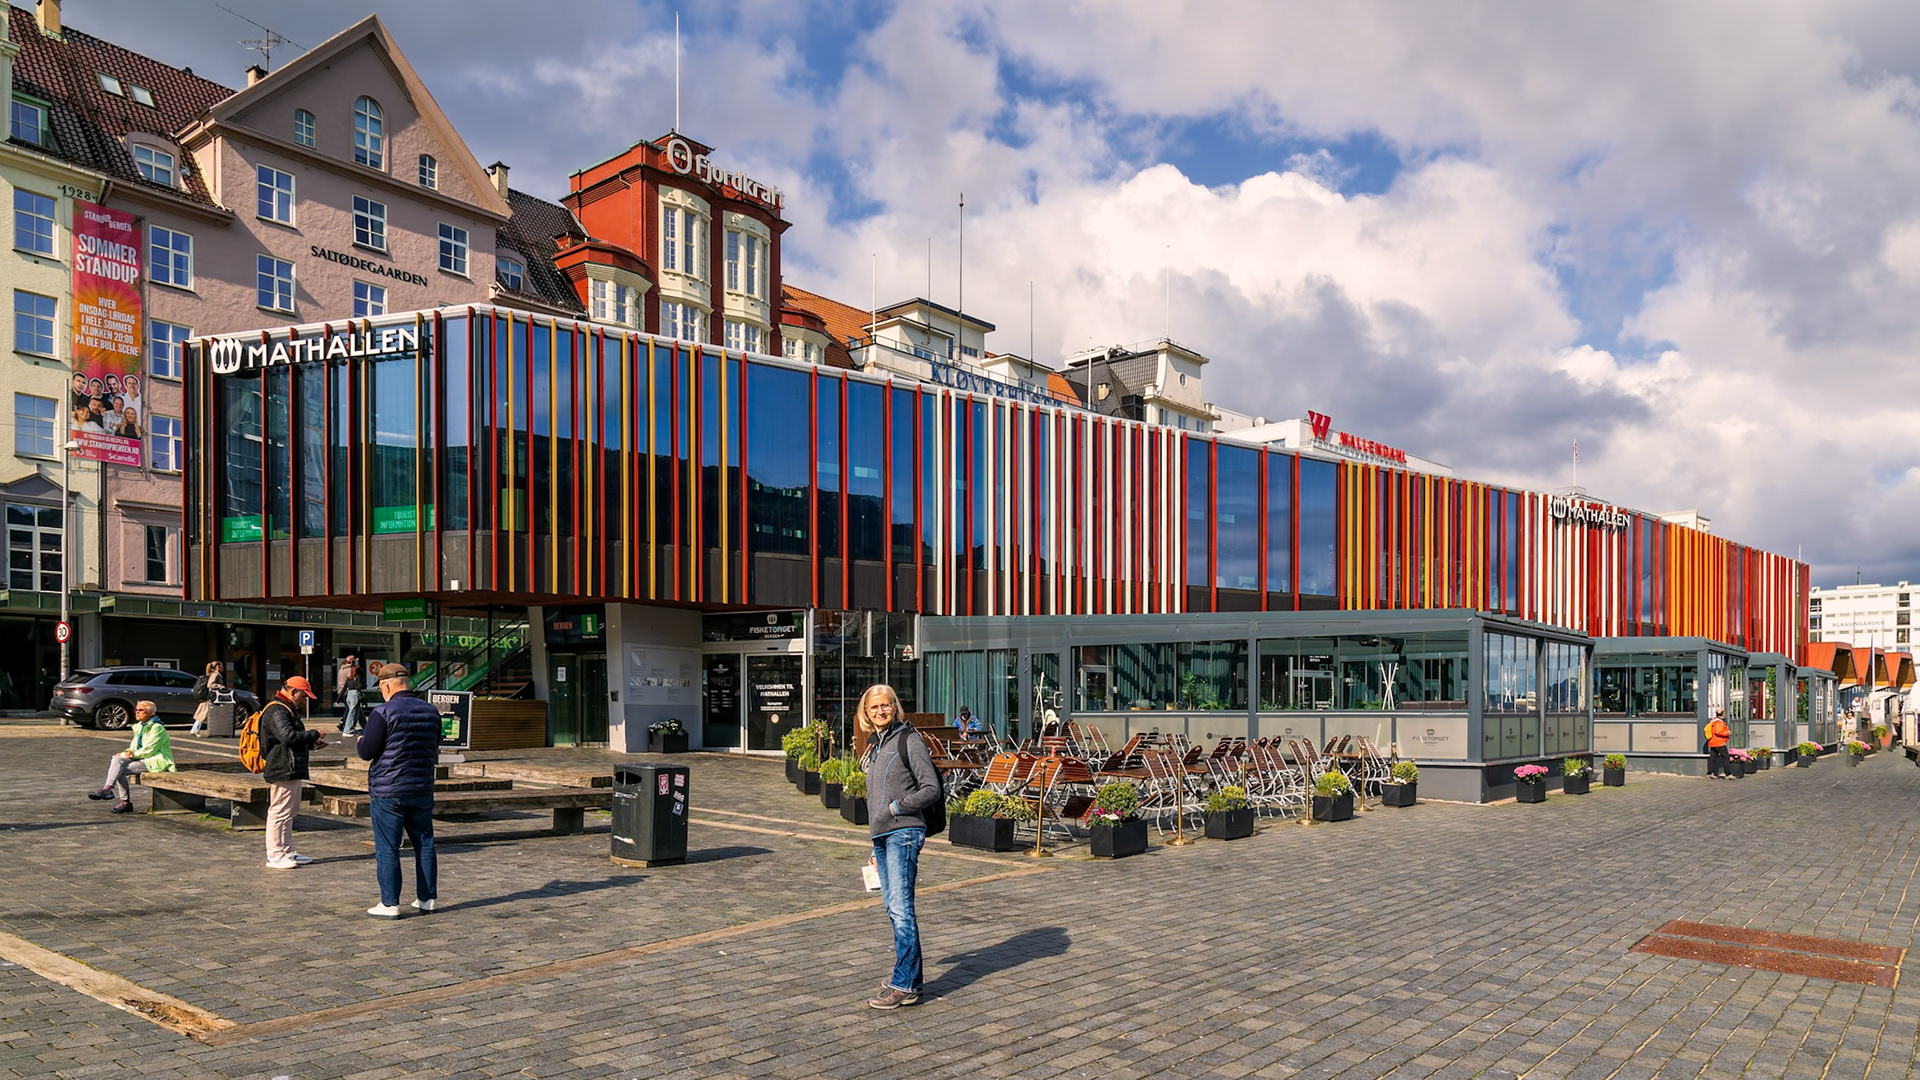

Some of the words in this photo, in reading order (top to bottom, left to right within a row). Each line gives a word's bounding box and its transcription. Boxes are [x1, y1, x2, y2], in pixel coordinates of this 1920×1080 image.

[695, 153, 786, 210] Fjordkraft
[84, 210, 112, 223] STANDUP
[108, 220, 132, 232] BERGEN
[78, 233, 137, 265] SOMMER
[75, 253, 139, 284] STANDUP
[311, 245, 428, 287] SALTØDEGAARDEN
[98, 297, 117, 310] HVER
[81, 314, 85, 324] I
[85, 315, 103, 328] HELE
[103, 319, 133, 335] SOMMER
[81, 325, 113, 340] KLOKKEN
[86, 336, 99, 348] OLE
[100, 339, 117, 352] BULL
[117, 343, 139, 357] SCENE
[248, 326, 419, 368] MATHALLEN
[1340, 432, 1407, 463] WALLENDAHL
[108, 453, 137, 463] Scandic
[1568, 507, 1630, 528] MATHALLEN
[385, 606, 404, 614] Visitor
[58, 627, 67, 638] 30
[749, 625, 796, 634] FISKETORGET
[302, 632, 311, 645] P
[432, 694, 460, 704] BERGEN
